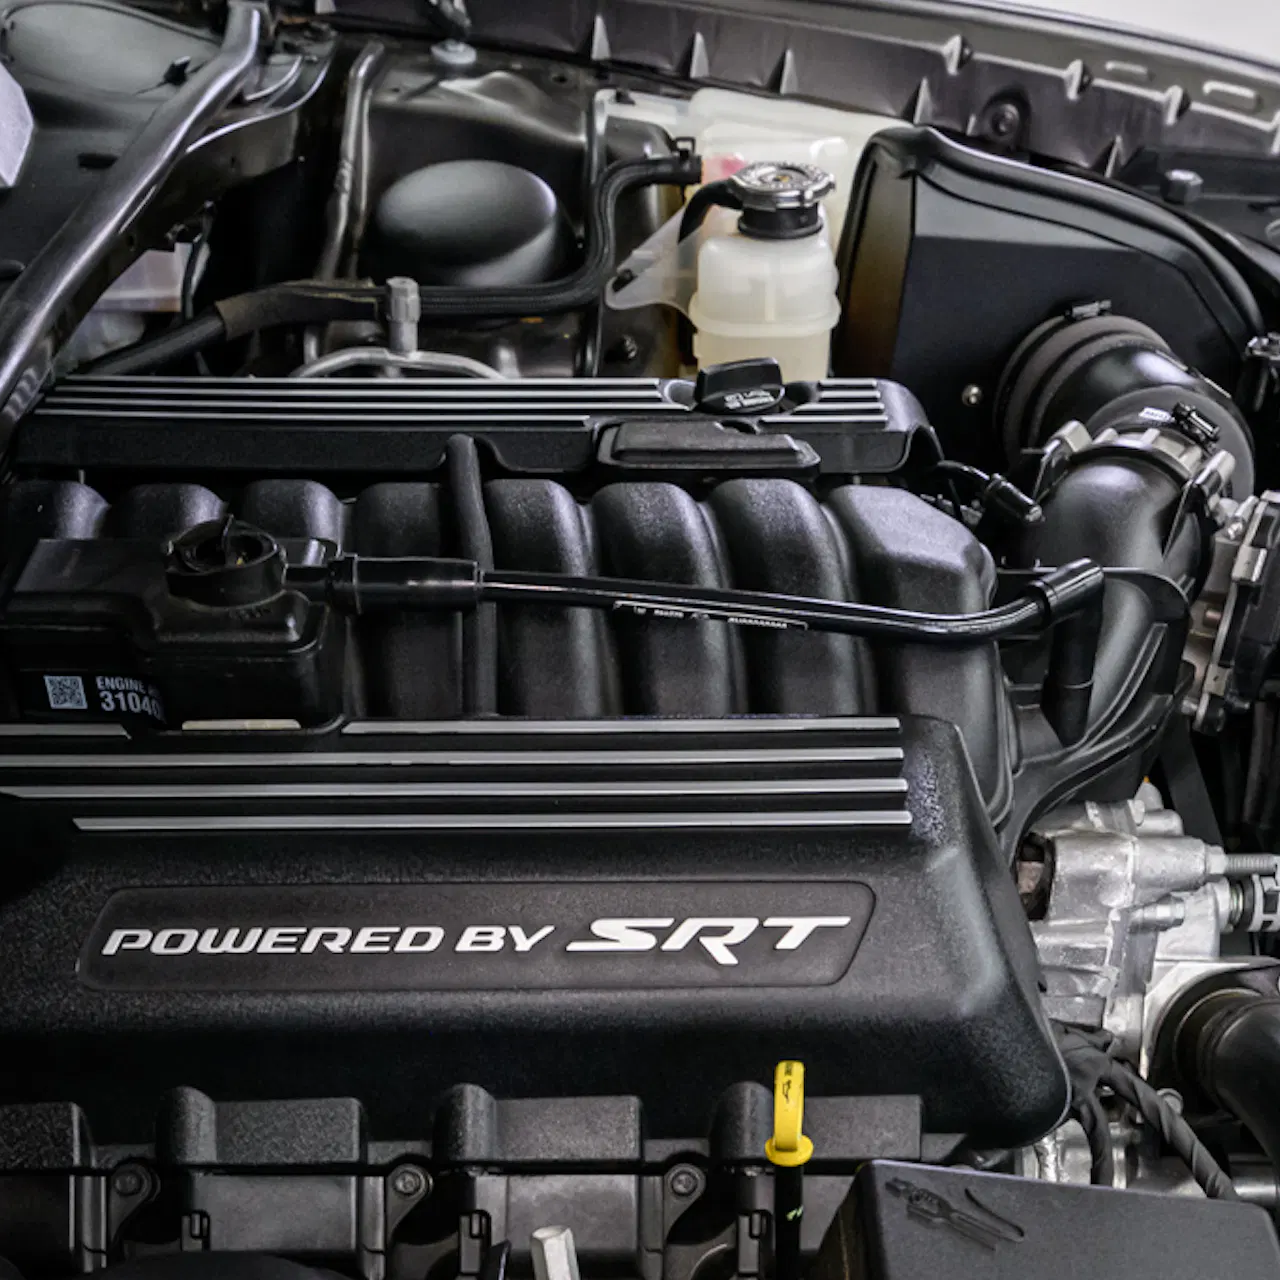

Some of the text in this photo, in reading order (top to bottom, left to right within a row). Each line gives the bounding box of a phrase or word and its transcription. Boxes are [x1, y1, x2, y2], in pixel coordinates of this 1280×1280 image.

[95, 675, 147, 694] ENGINE
[101, 916, 852, 965] POWERED BY SRT
